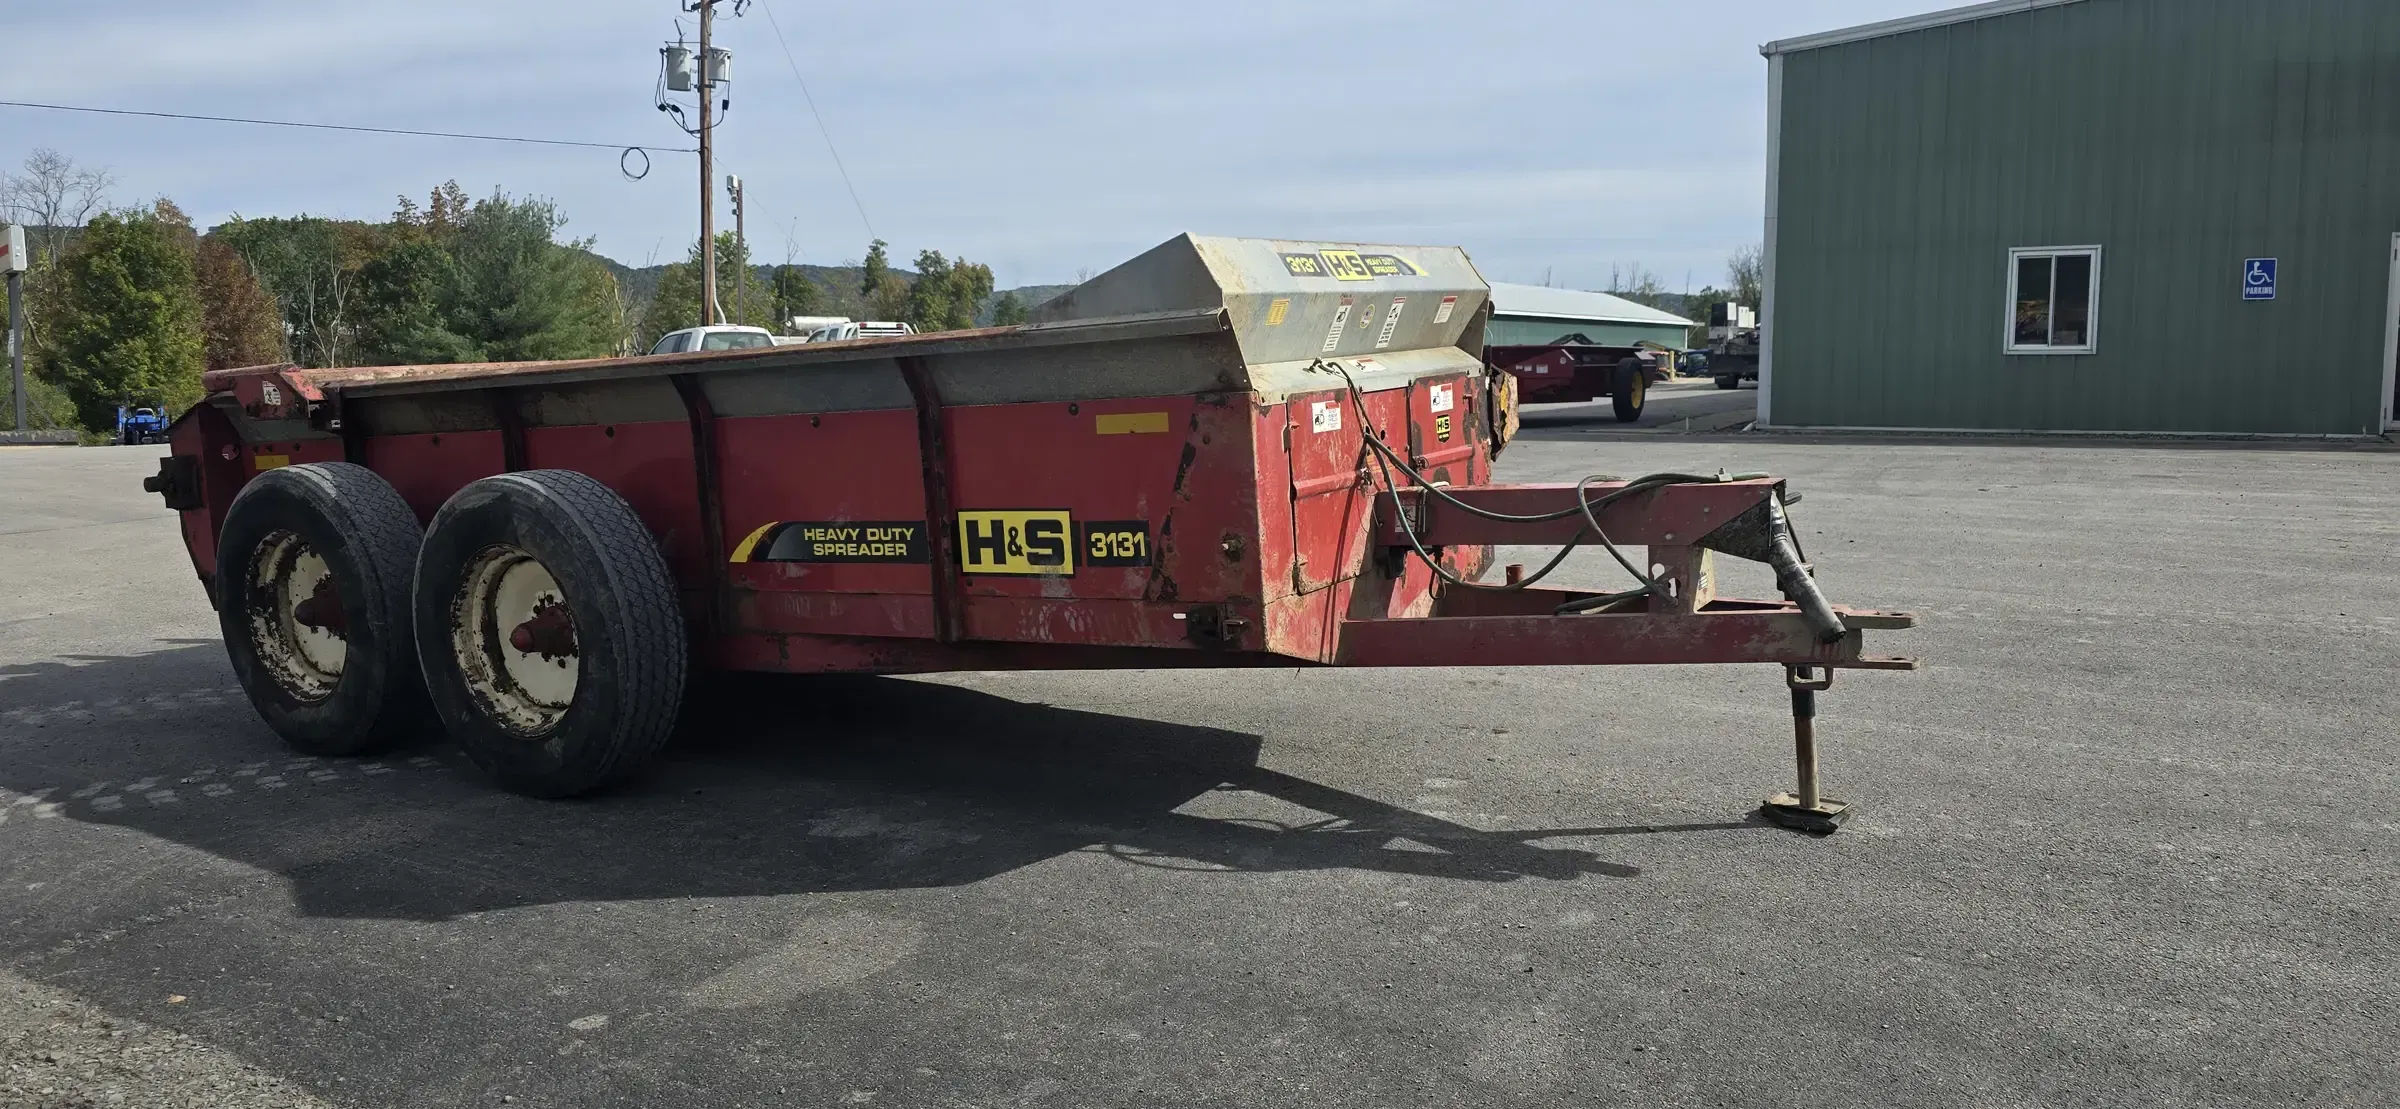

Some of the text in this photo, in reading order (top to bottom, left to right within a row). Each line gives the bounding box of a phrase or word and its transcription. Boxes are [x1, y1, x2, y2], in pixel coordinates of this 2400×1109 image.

[1286, 256, 1320, 273] 3131
[1325, 254, 1368, 277] H&S
[1365, 257, 1382, 265] HEAVY
[2245, 287, 2273, 295] PARKING
[804, 527, 914, 542] HEAVY DUTY
[966, 519, 1065, 566] H&S
[813, 543, 908, 557] SPREADER
[1090, 532, 1147, 558] 3131
